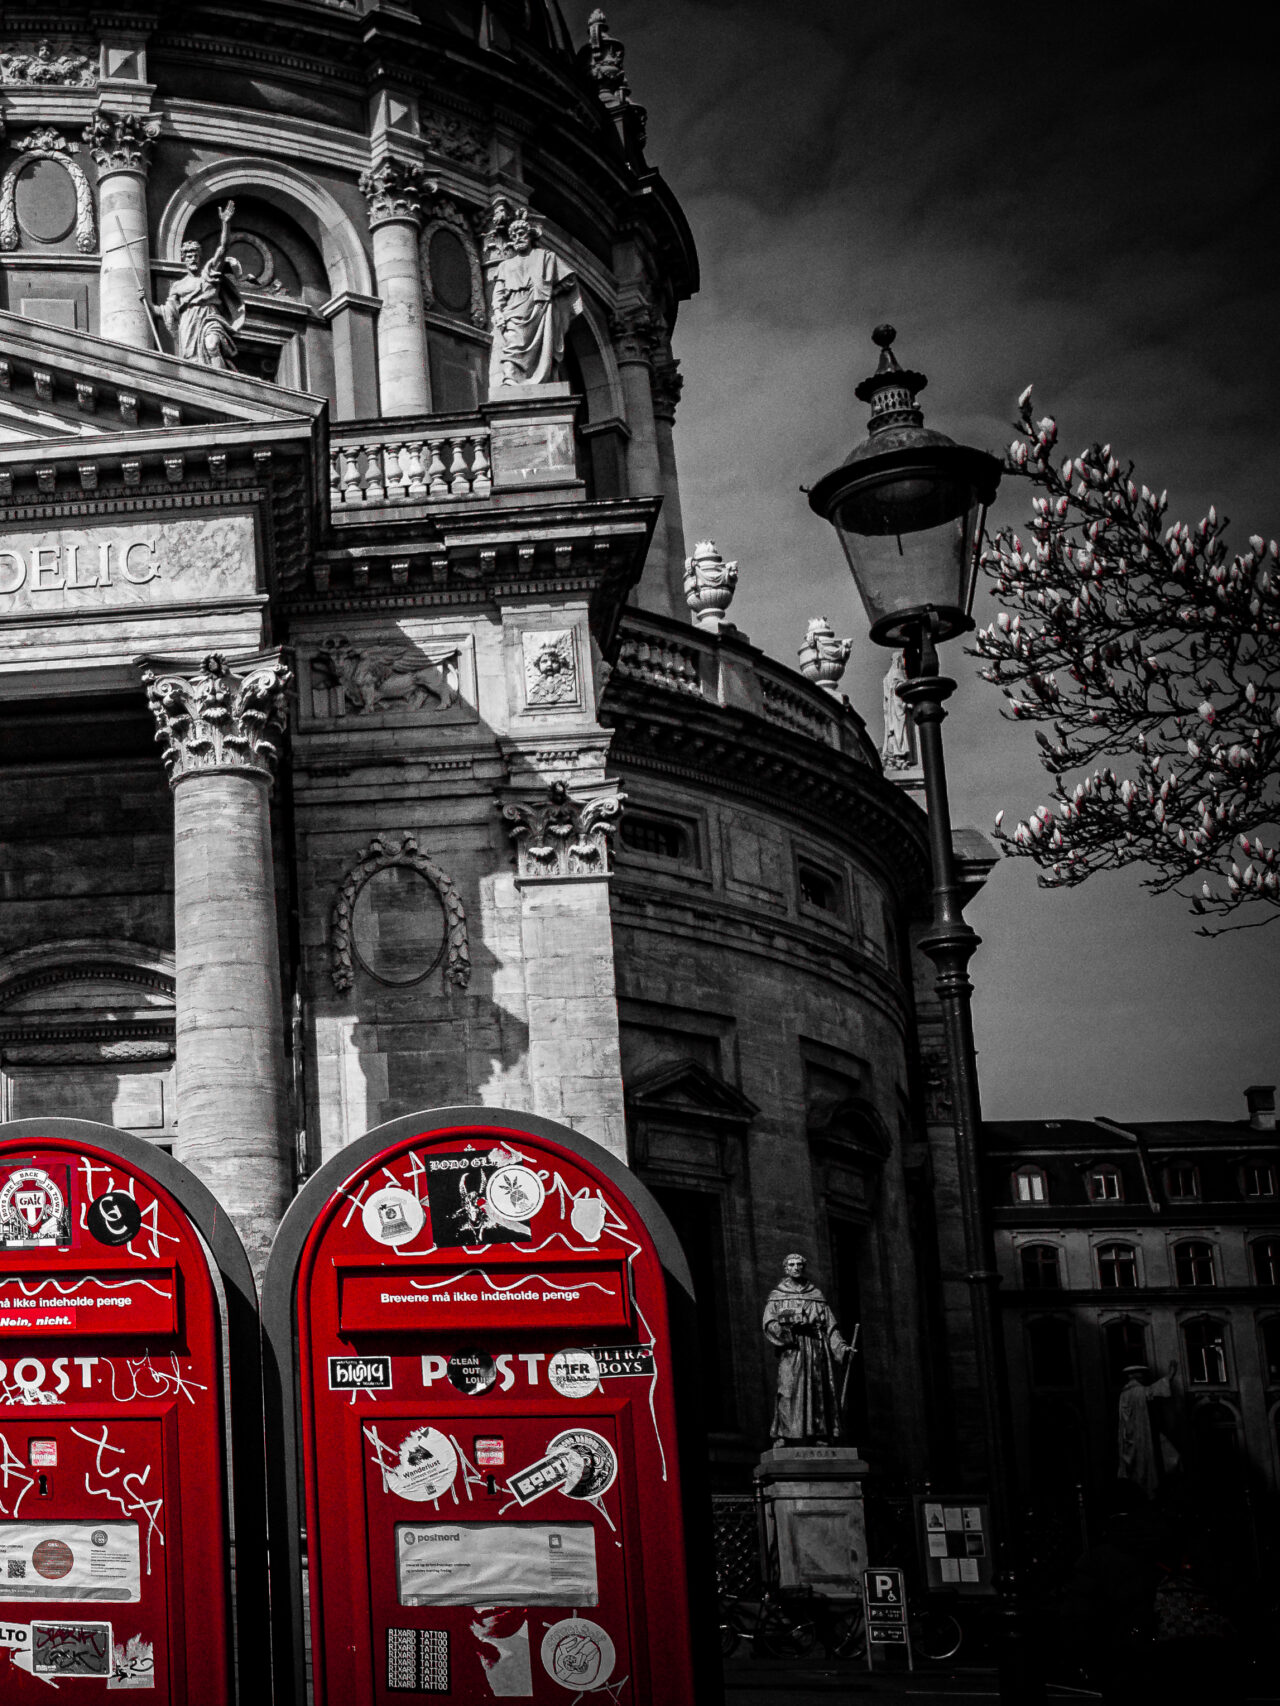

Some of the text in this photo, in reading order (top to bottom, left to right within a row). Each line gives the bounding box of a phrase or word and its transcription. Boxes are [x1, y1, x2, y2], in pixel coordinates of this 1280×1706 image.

[13, 1297, 37, 1308] ikke
[39, 1296, 94, 1308] indeholde
[96, 1297, 132, 1308] penge
[380, 1290, 580, 1304] Brevene må ikke indeholde penge
[0, 1315, 73, 1328] Nein, nicht.
[450, 1358, 480, 1366] CLEAN
[421, 1353, 545, 1392] PST
[462, 1367, 481, 1375] OUT
[599, 1361, 643, 1375] BOYS
[402, 1459, 441, 1479] Wanderlust
[417, 1533, 460, 1543] postnord
[875, 1575, 893, 1598] P
[388, 1628, 448, 1639] RIXARD TATTOO
[388, 1636, 448, 1646] RIXARD TATTOO
[388, 1643, 448, 1654] RIXARD TATTOO
[388, 1650, 448, 1661] RIXARD TATTOO
[388, 1658, 448, 1668] RIXARD TATTOO
[388, 1665, 448, 1676] RIXARD TATTOO
[388, 1672, 448, 1683] RIXARD TATTOO
[388, 1680, 448, 1690] RIXARD TATTOO
